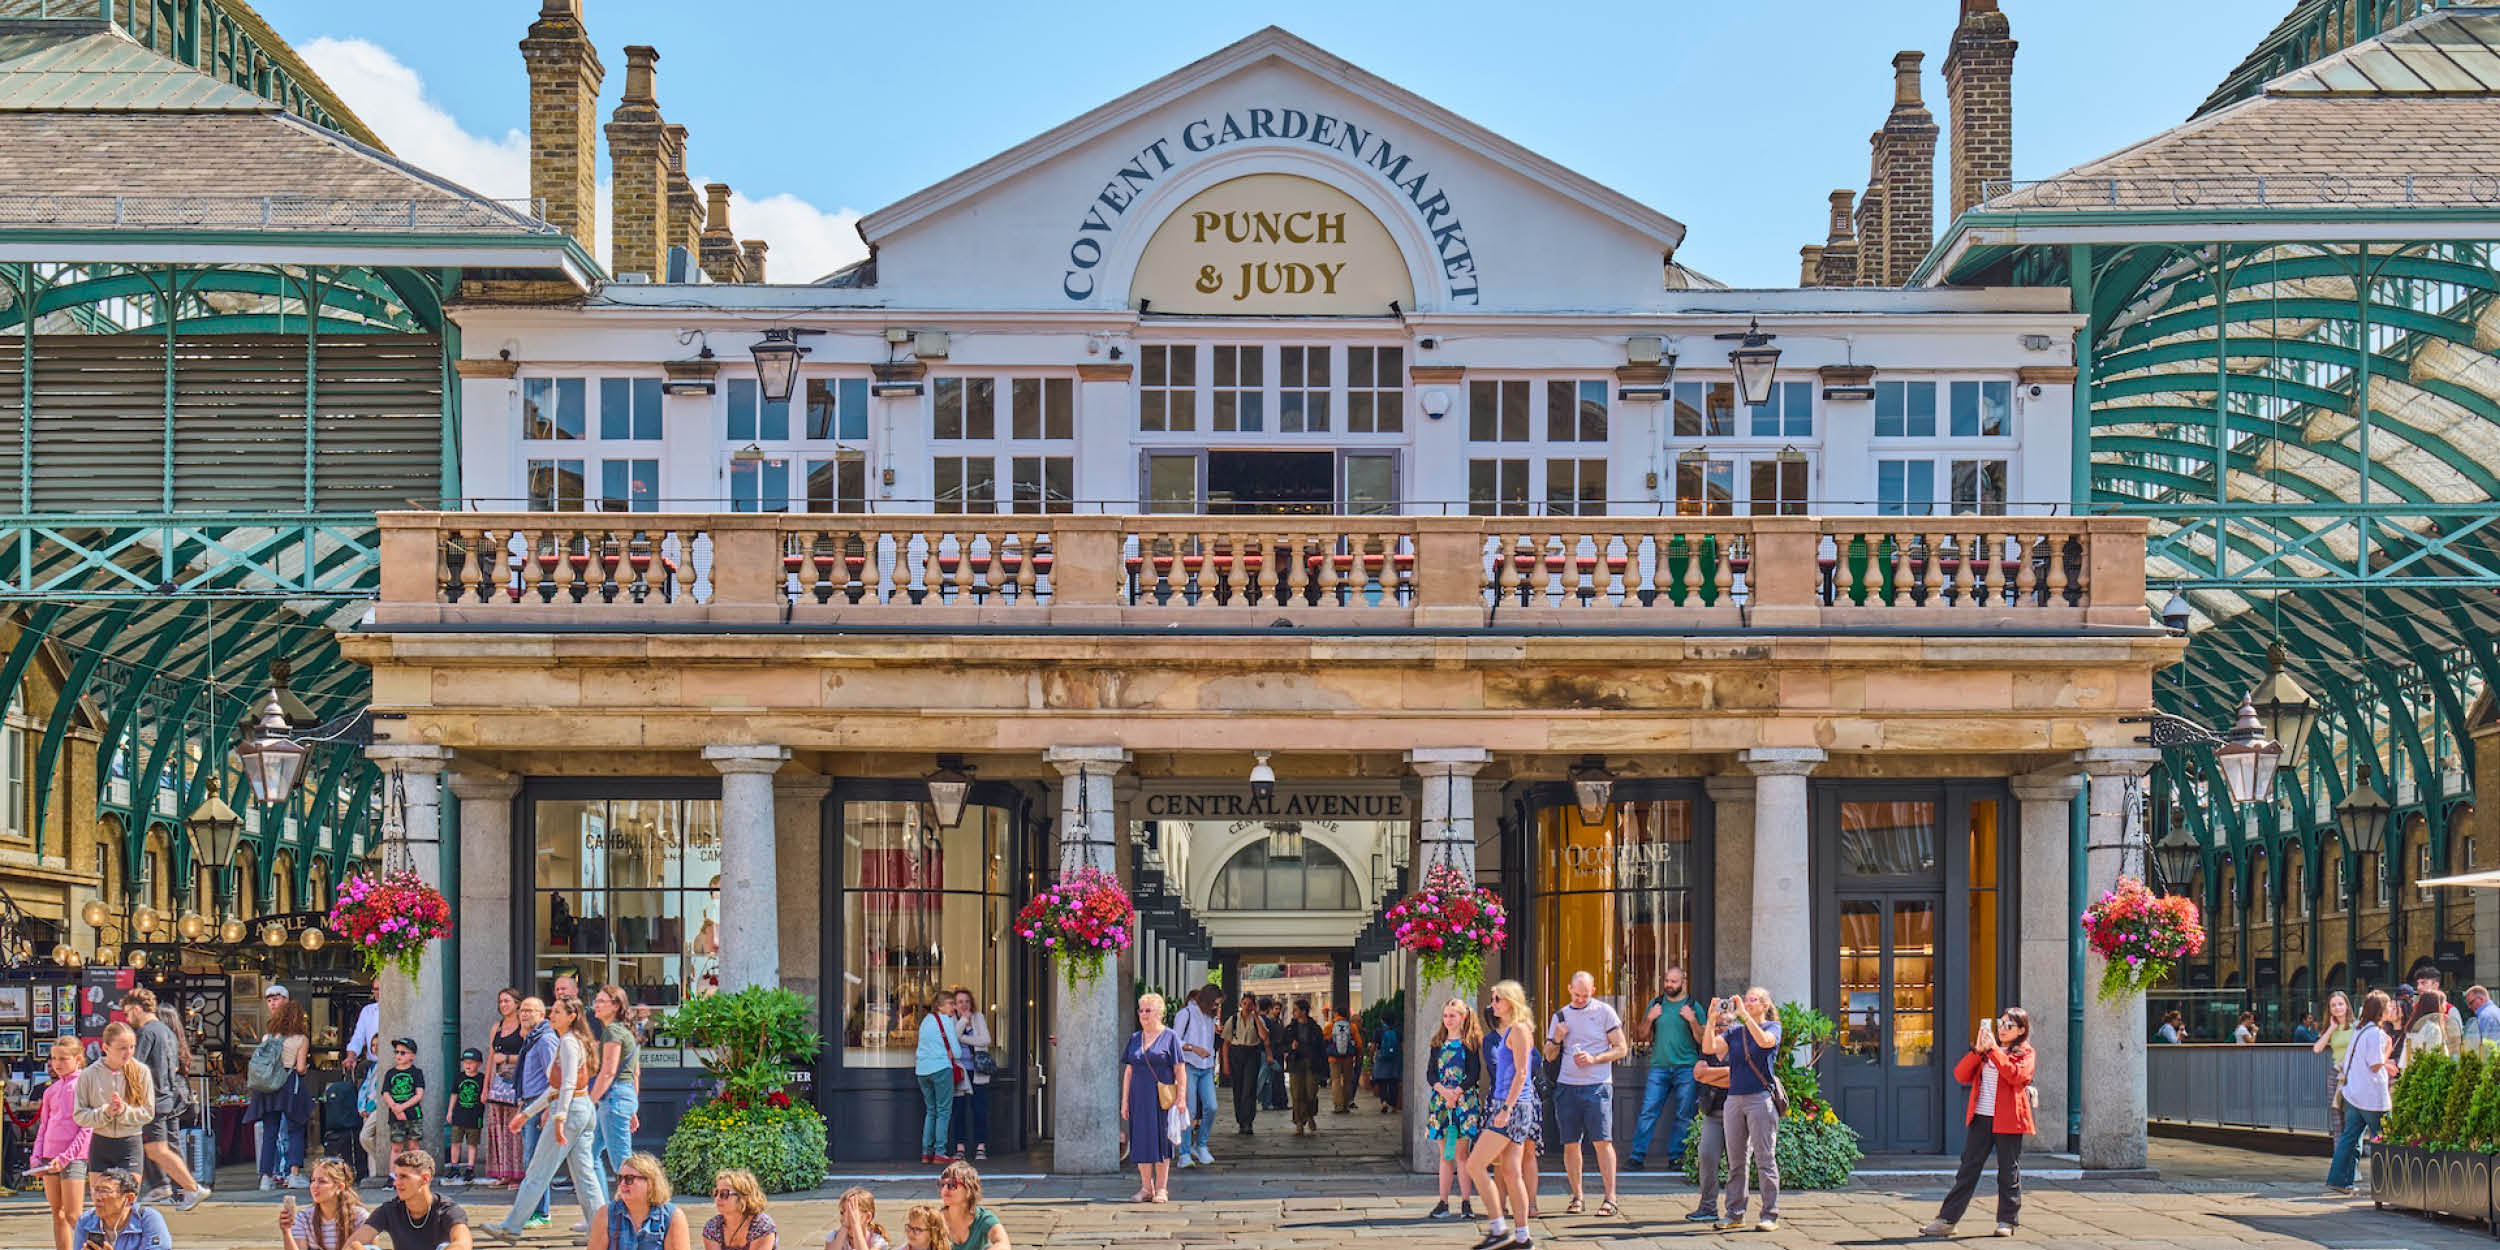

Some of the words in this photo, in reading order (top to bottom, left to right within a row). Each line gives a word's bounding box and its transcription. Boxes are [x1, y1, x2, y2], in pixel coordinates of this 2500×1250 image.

[1063, 138, 1174, 301] COVENT
[1182, 108, 1372, 159] GARDEN
[1369, 139, 1479, 305] MARKET
[1193, 211, 1347, 244] PUNCH
[1195, 265, 1223, 294] &
[1234, 262, 1346, 300] JUDY
[1146, 794, 1280, 816] CENTRAL
[1286, 794, 1404, 816] AVENUE
